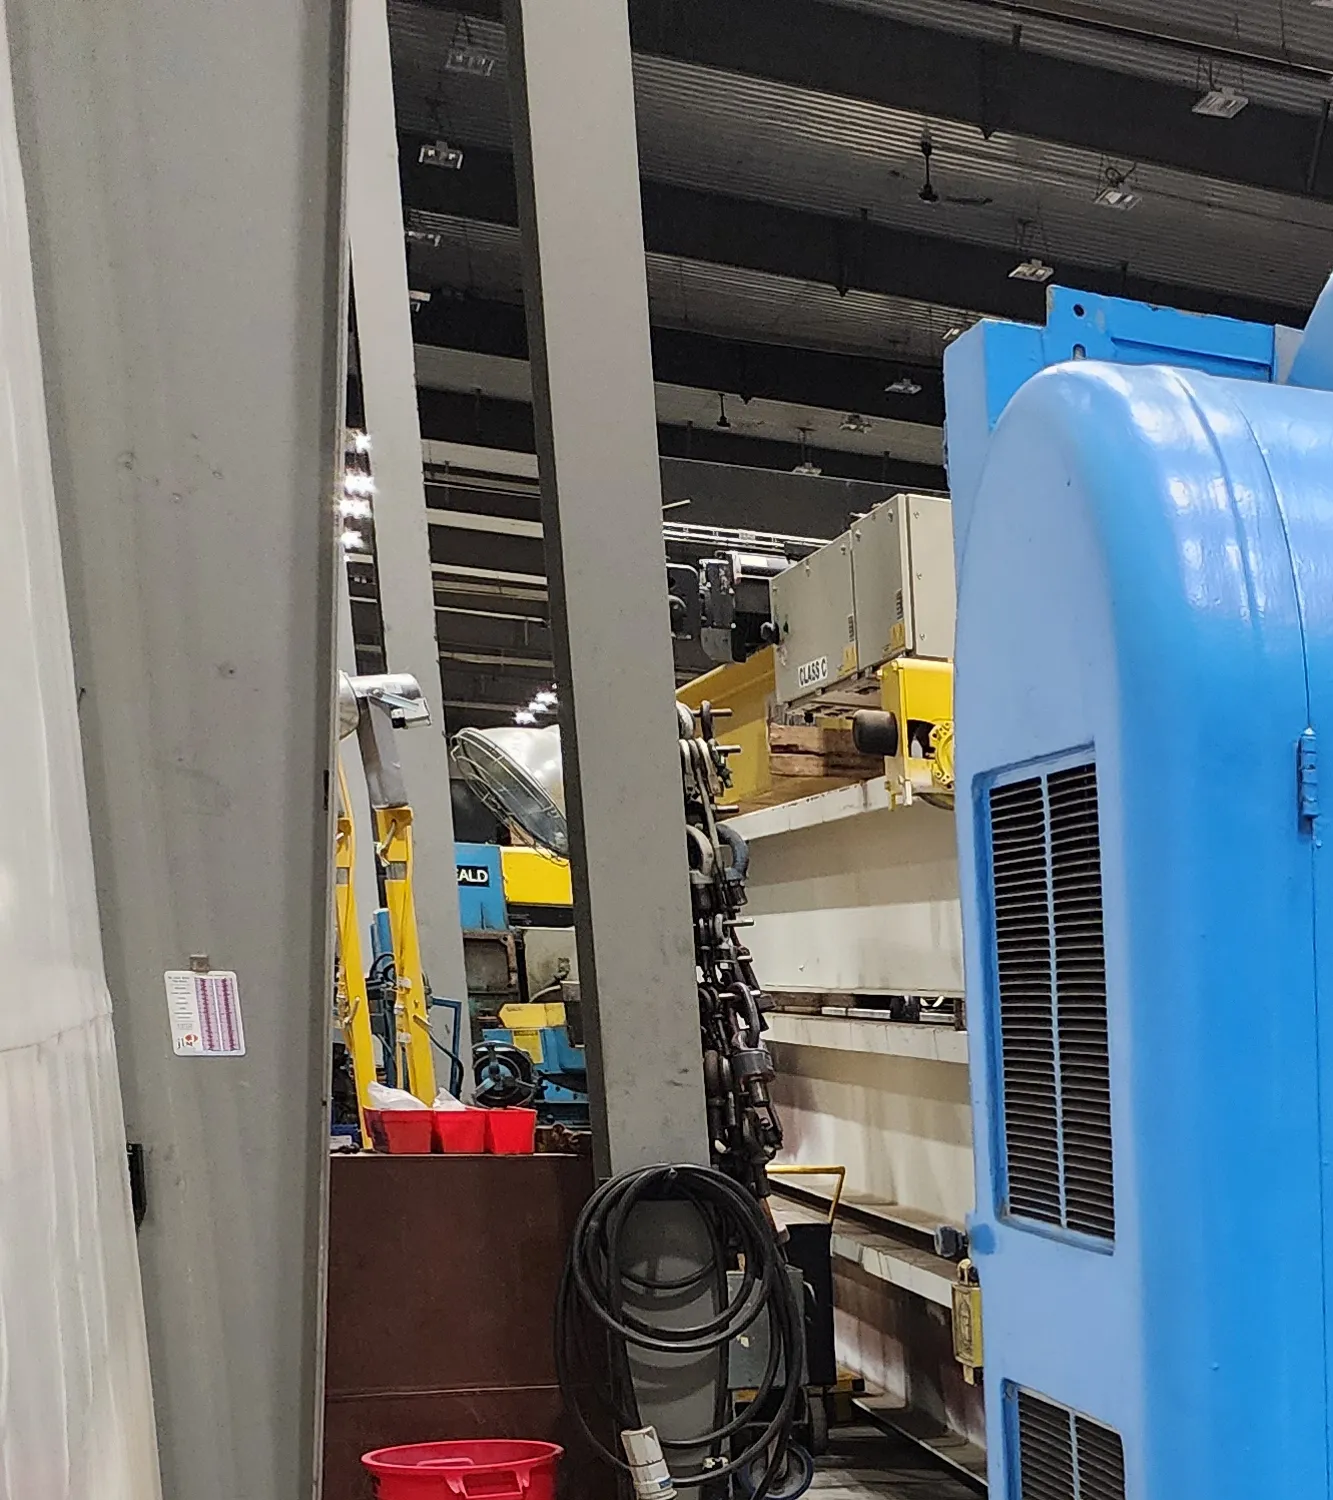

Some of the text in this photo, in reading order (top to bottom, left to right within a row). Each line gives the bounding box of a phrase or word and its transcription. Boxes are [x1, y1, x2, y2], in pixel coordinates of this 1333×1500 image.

[800, 658, 827, 686] CLASS C
[457, 868, 489, 883] ALD
